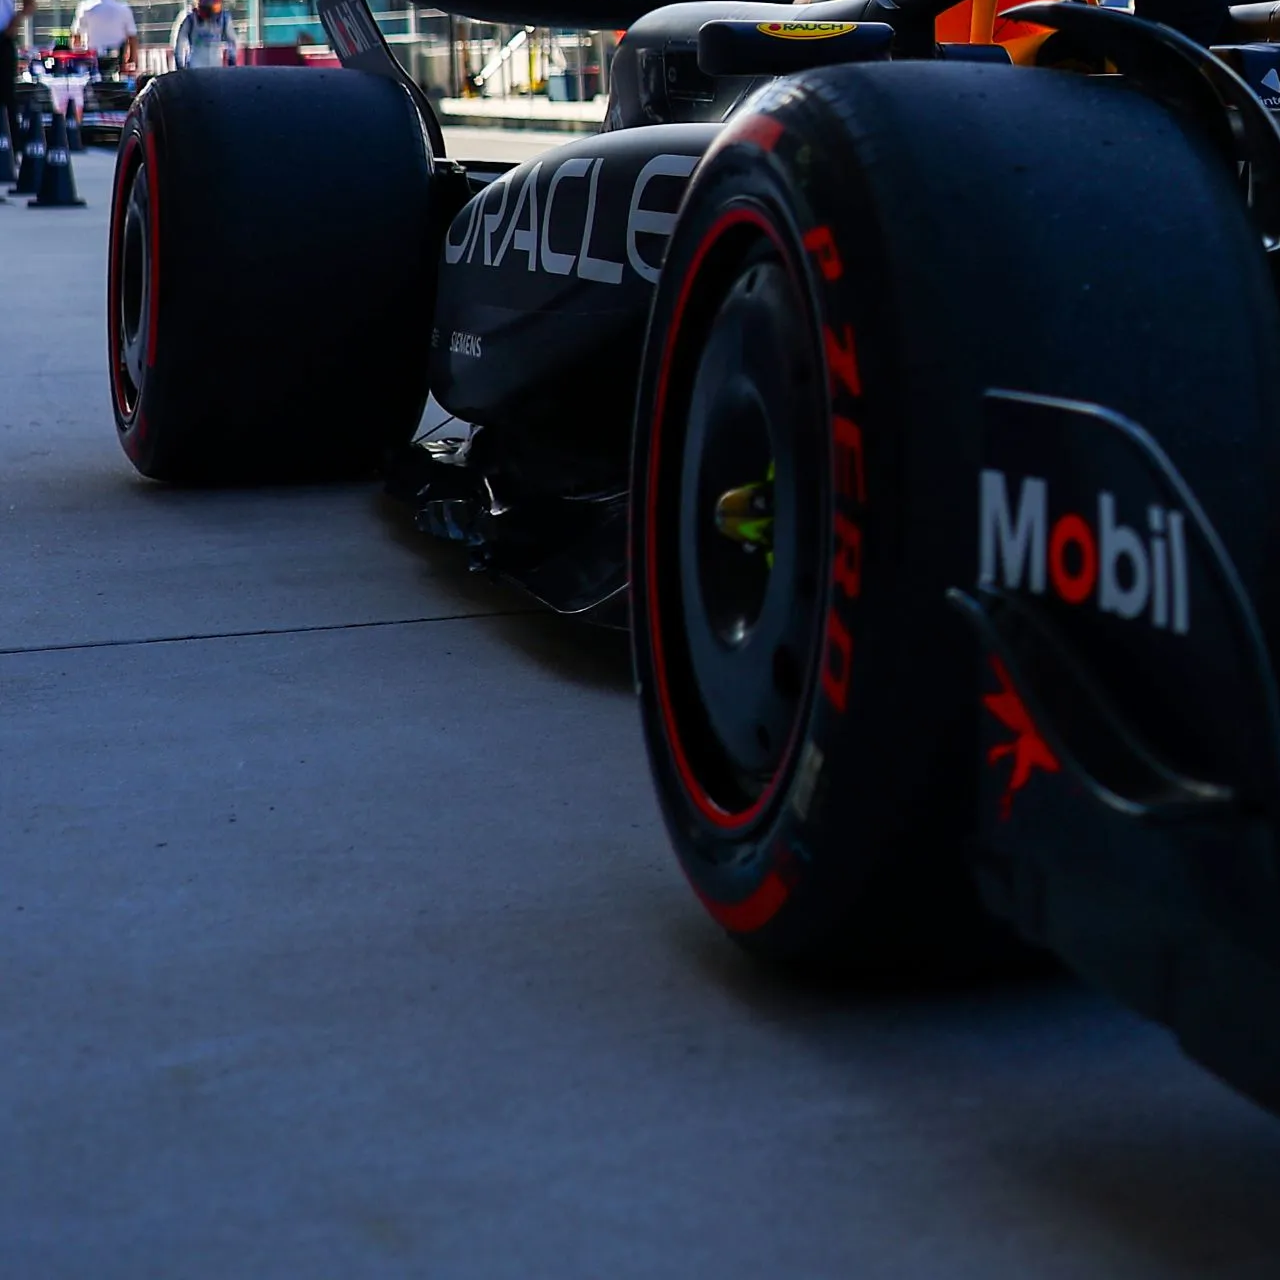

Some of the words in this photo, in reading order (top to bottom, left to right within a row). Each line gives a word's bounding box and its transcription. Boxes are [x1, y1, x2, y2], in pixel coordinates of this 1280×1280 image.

[783, 23, 844, 31] RAUCH
[446, 154, 702, 284] ORACLE
[449, 331, 482, 357] SIEMENS
[978, 469, 1190, 636] Mobil
